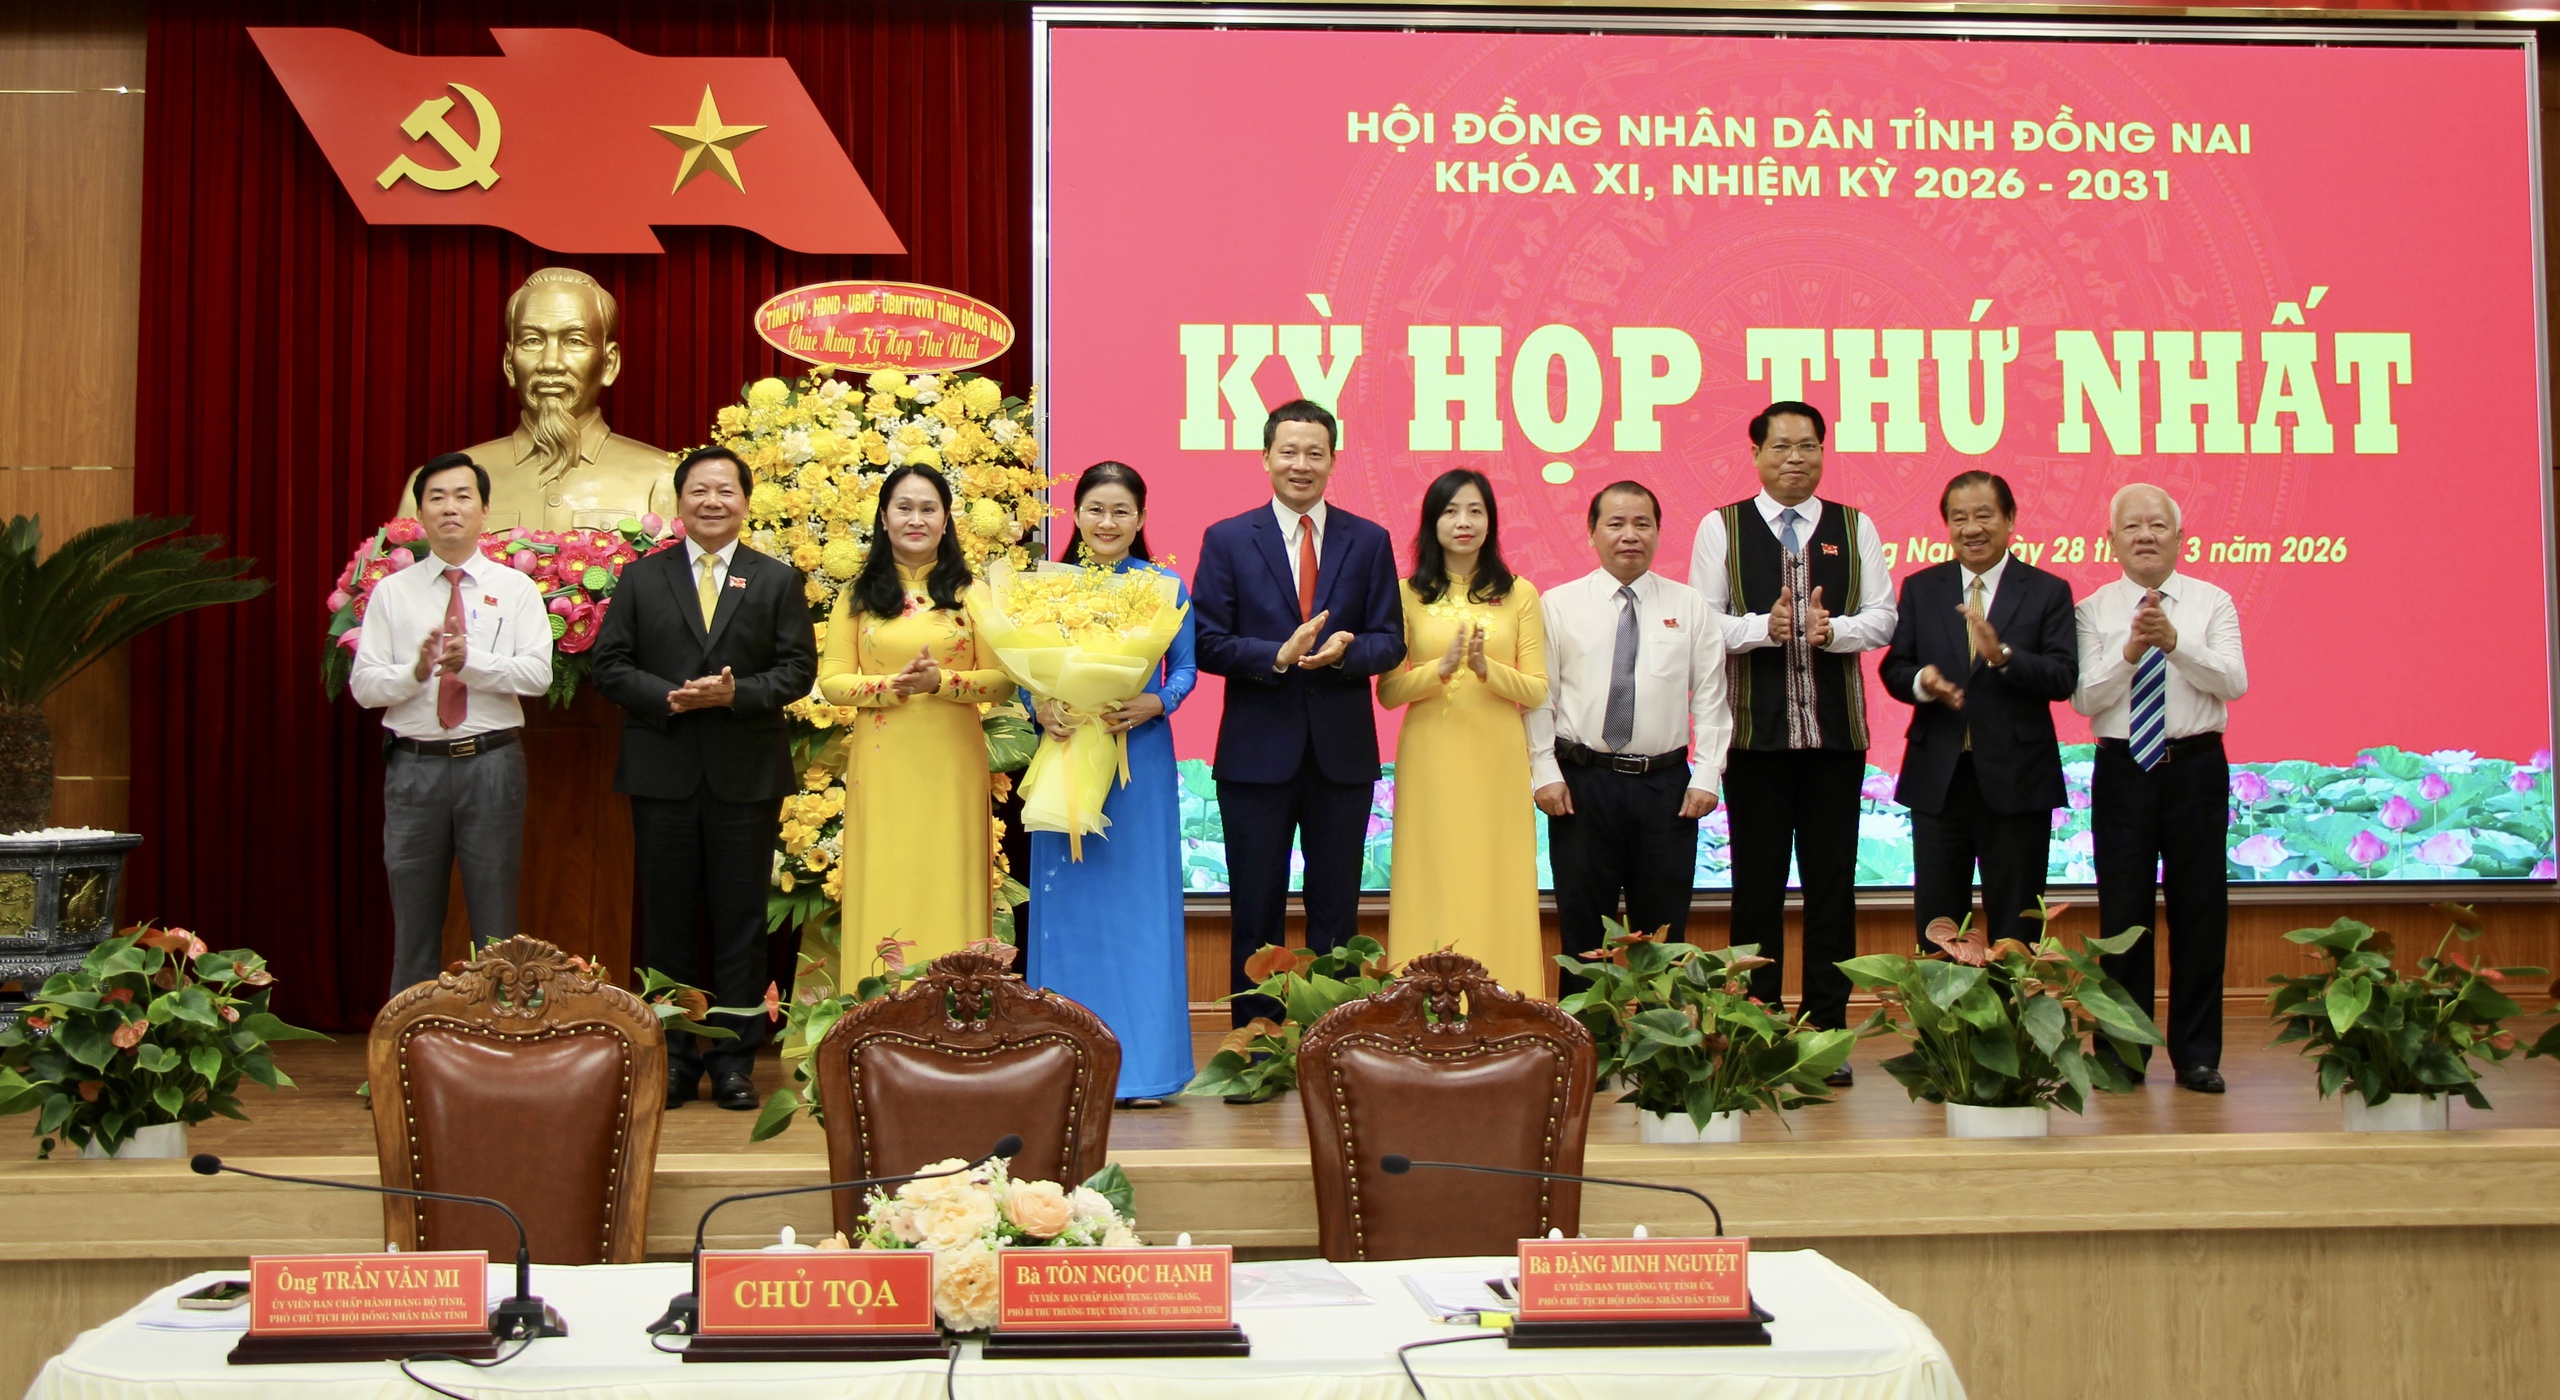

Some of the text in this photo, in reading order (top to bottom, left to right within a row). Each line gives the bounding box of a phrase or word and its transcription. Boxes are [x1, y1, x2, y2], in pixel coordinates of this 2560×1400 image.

[1347, 96, 2251, 154] HỘI ĐỒNG NHÂN DÂN TỈNH ĐỒNG NAI
[1435, 151, 2169, 206] KHÓA XI, NHIỆM KỲ 2026 - 2031
[766, 301, 790, 331] TỈNH
[792, 294, 807, 322] ỦY
[813, 295, 841, 318] HĐND
[848, 294, 875, 314] UBND
[882, 292, 935, 319] UBMTTQVN
[936, 294, 960, 326] TỈNH
[961, 302, 988, 337] ĐỒNG
[989, 318, 1007, 346] NAI
[788, 323, 819, 352] Chúc
[819, 325, 857, 360] Mừng
[884, 328, 914, 363] Họp
[917, 328, 945, 358] Thứ
[946, 330, 980, 360] Nhất
[1179, 285, 2413, 485] KỲ HỌP THỨ NHẤT
[2050, 536, 2086, 563] 28
[2184, 536, 2202, 563] 3
[2209, 535, 2272, 563] năm
[2279, 536, 2348, 563] 2026
[277, 1261, 460, 1295] Ông TRẦN VĂN MI
[1016, 1259, 1214, 1289] Bà TÔN NGỌC HẠNH
[1529, 1247, 1739, 1279] Bà ĐẶNG MINH NGUYỆT
[287, 1298, 311, 1309] VIÊN
[313, 1299, 334, 1308] BAN
[335, 1296, 363, 1308] CHẤP
[364, 1296, 392, 1308] HÀNH
[423, 1295, 438, 1309] BỘ
[734, 1268, 899, 1315] CHỦ TỌA
[1063, 1293, 1080, 1302] BAN
[1594, 1282, 1614, 1291] BAN
[315, 1312, 340, 1324] TỊCH
[341, 1311, 360, 1324] HỘI
[391, 1309, 420, 1321] NHÂN
[421, 1309, 442, 1320] DÂN
